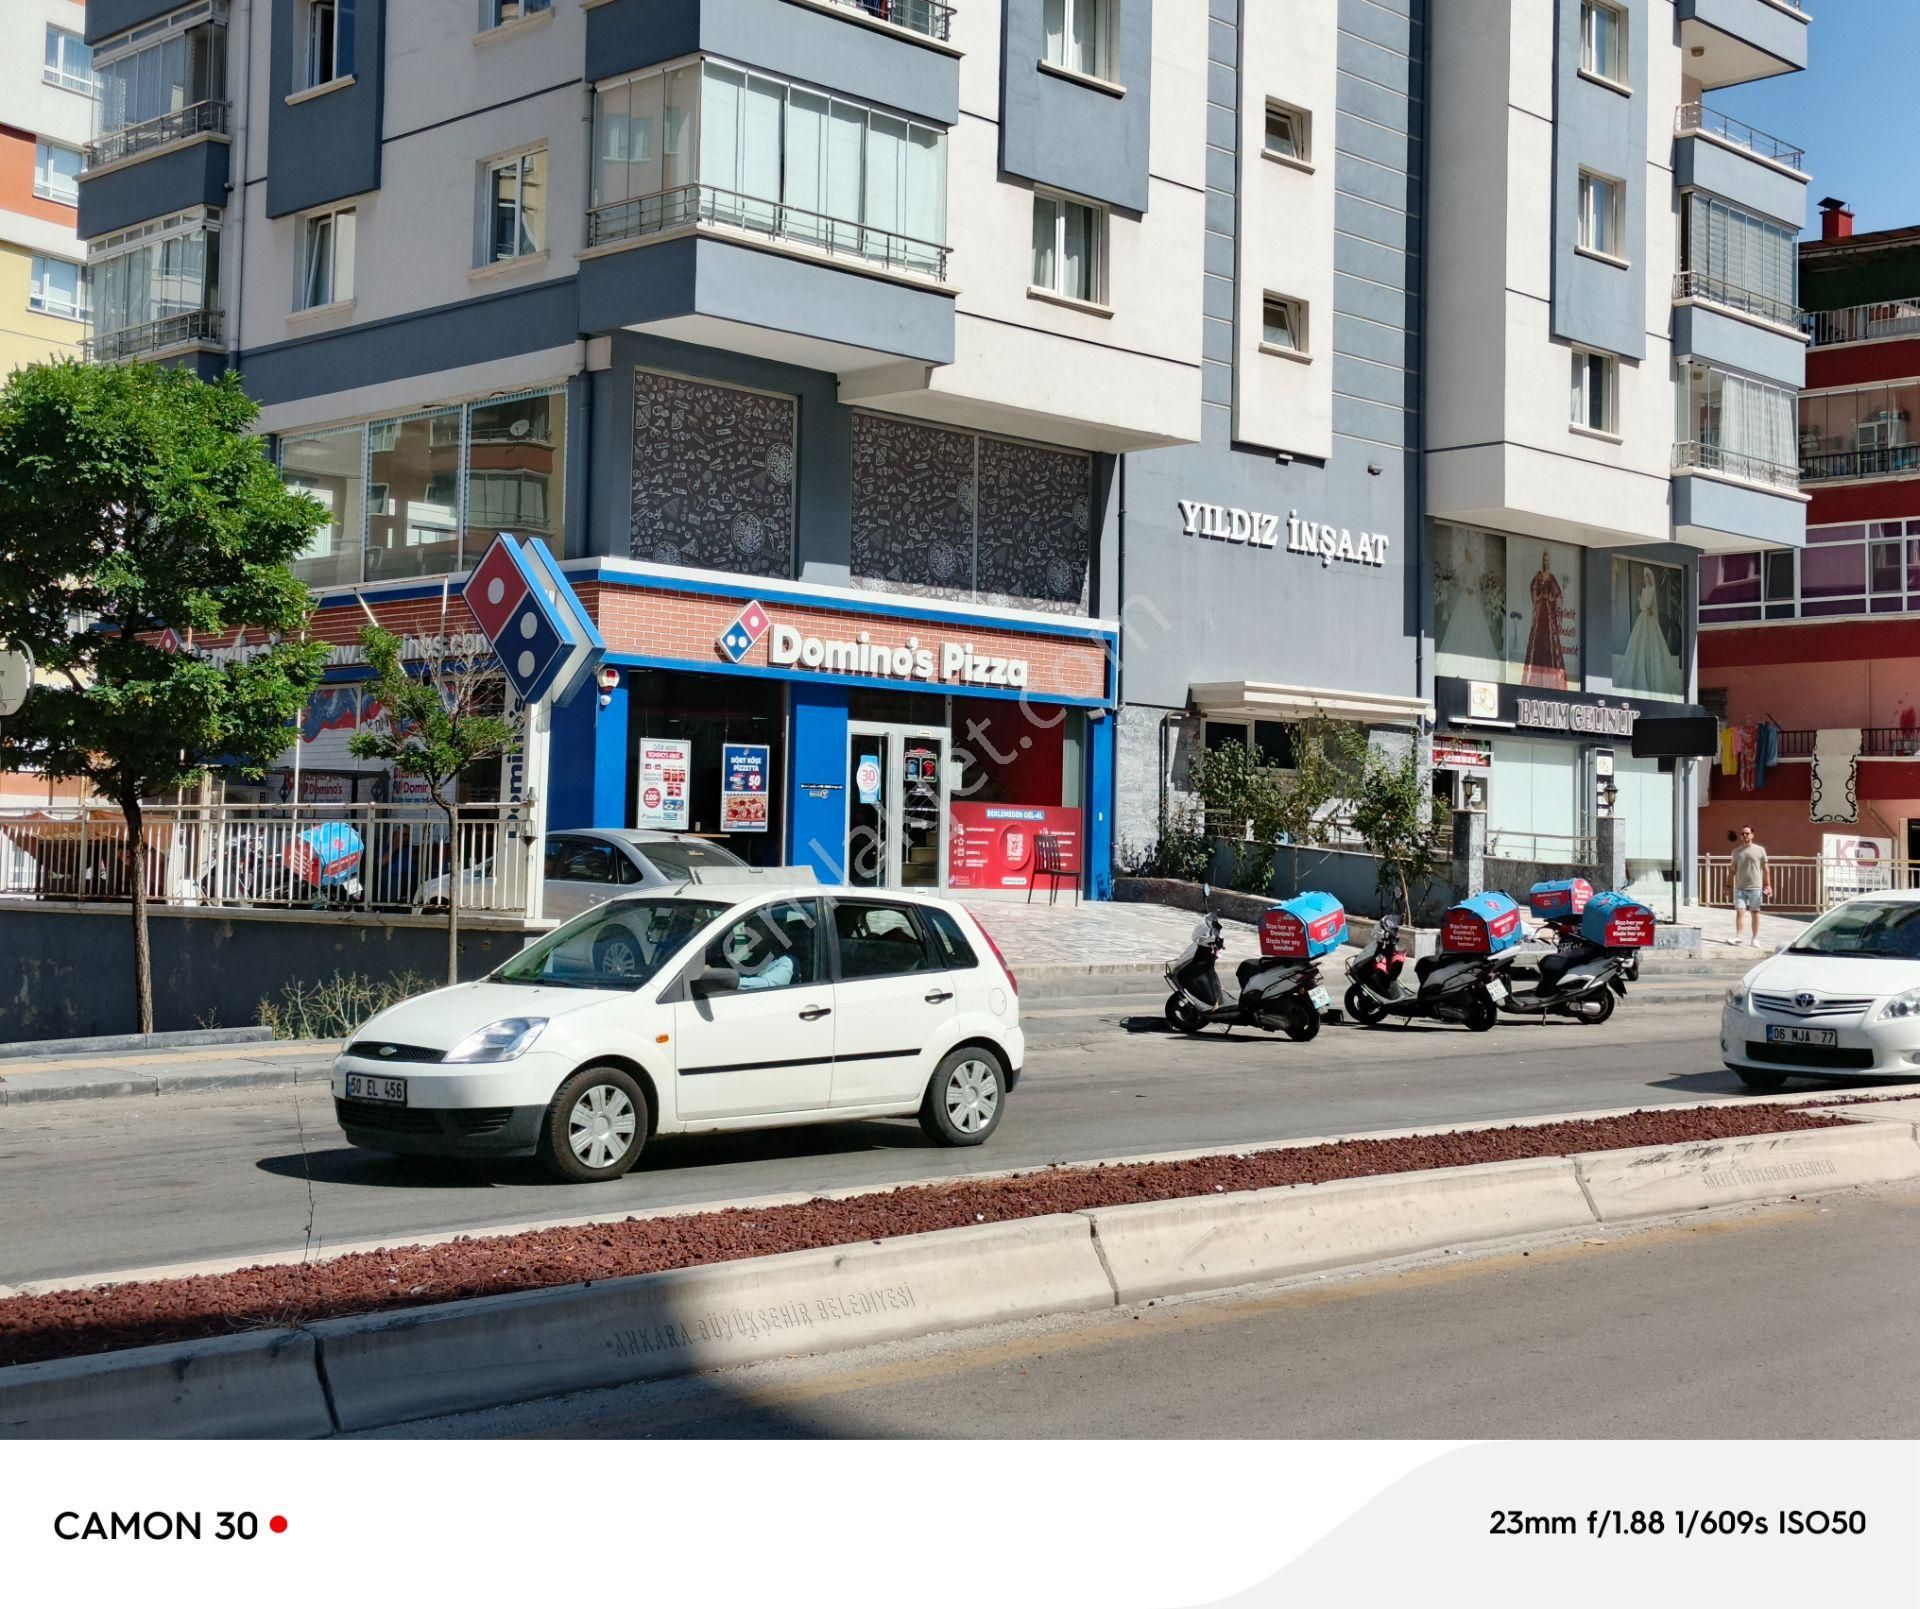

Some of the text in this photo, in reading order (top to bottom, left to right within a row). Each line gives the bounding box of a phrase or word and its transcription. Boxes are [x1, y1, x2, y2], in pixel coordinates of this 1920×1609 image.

[1178, 499, 1390, 568] YILDIZ İNŞAAT
[768, 623, 1029, 687] Domino's Pizza
[1516, 698, 1570, 730] BALIM
[748, 774, 761, 786] 50
[862, 769, 875, 781] 30
[1773, 1027, 1834, 1044] 06 MJA 77
[367, 1079, 378, 1097] EL
[384, 1080, 403, 1099] 456
[614, 1281, 918, 1358] ANKARA BÜYÜKŞEHİR BELEDİYESİ
